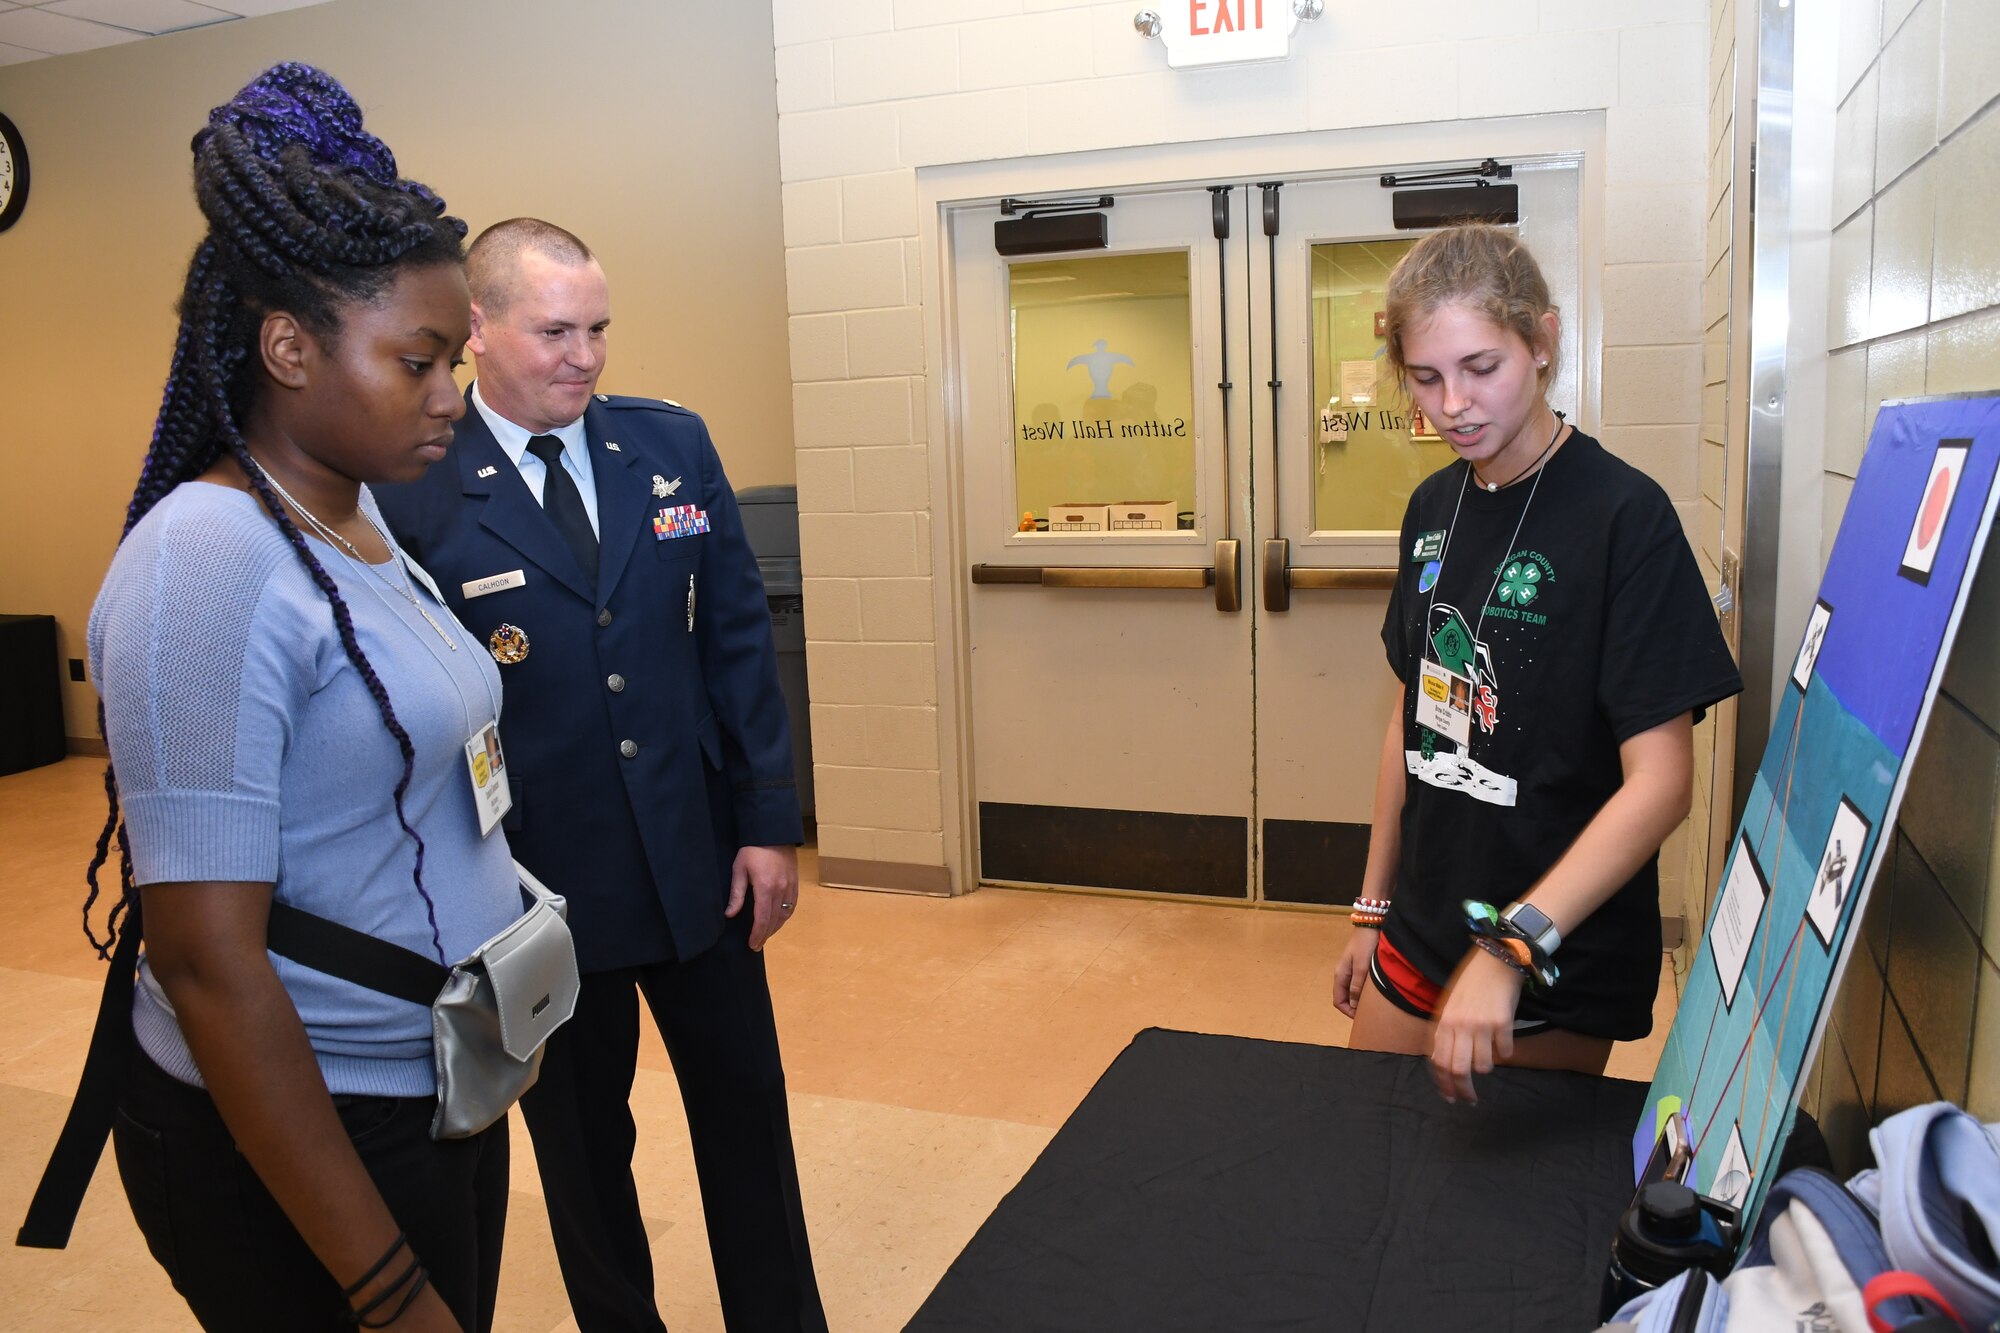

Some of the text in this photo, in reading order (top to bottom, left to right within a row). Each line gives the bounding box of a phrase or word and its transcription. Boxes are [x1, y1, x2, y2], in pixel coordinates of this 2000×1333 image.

[5, 161, 11, 173] 3
[4, 181, 10, 191] 4
[1529, 550, 1556, 583] COUNTY
[478, 578, 510, 592] CALHOON
[1521, 611, 1547, 626] TEAM
